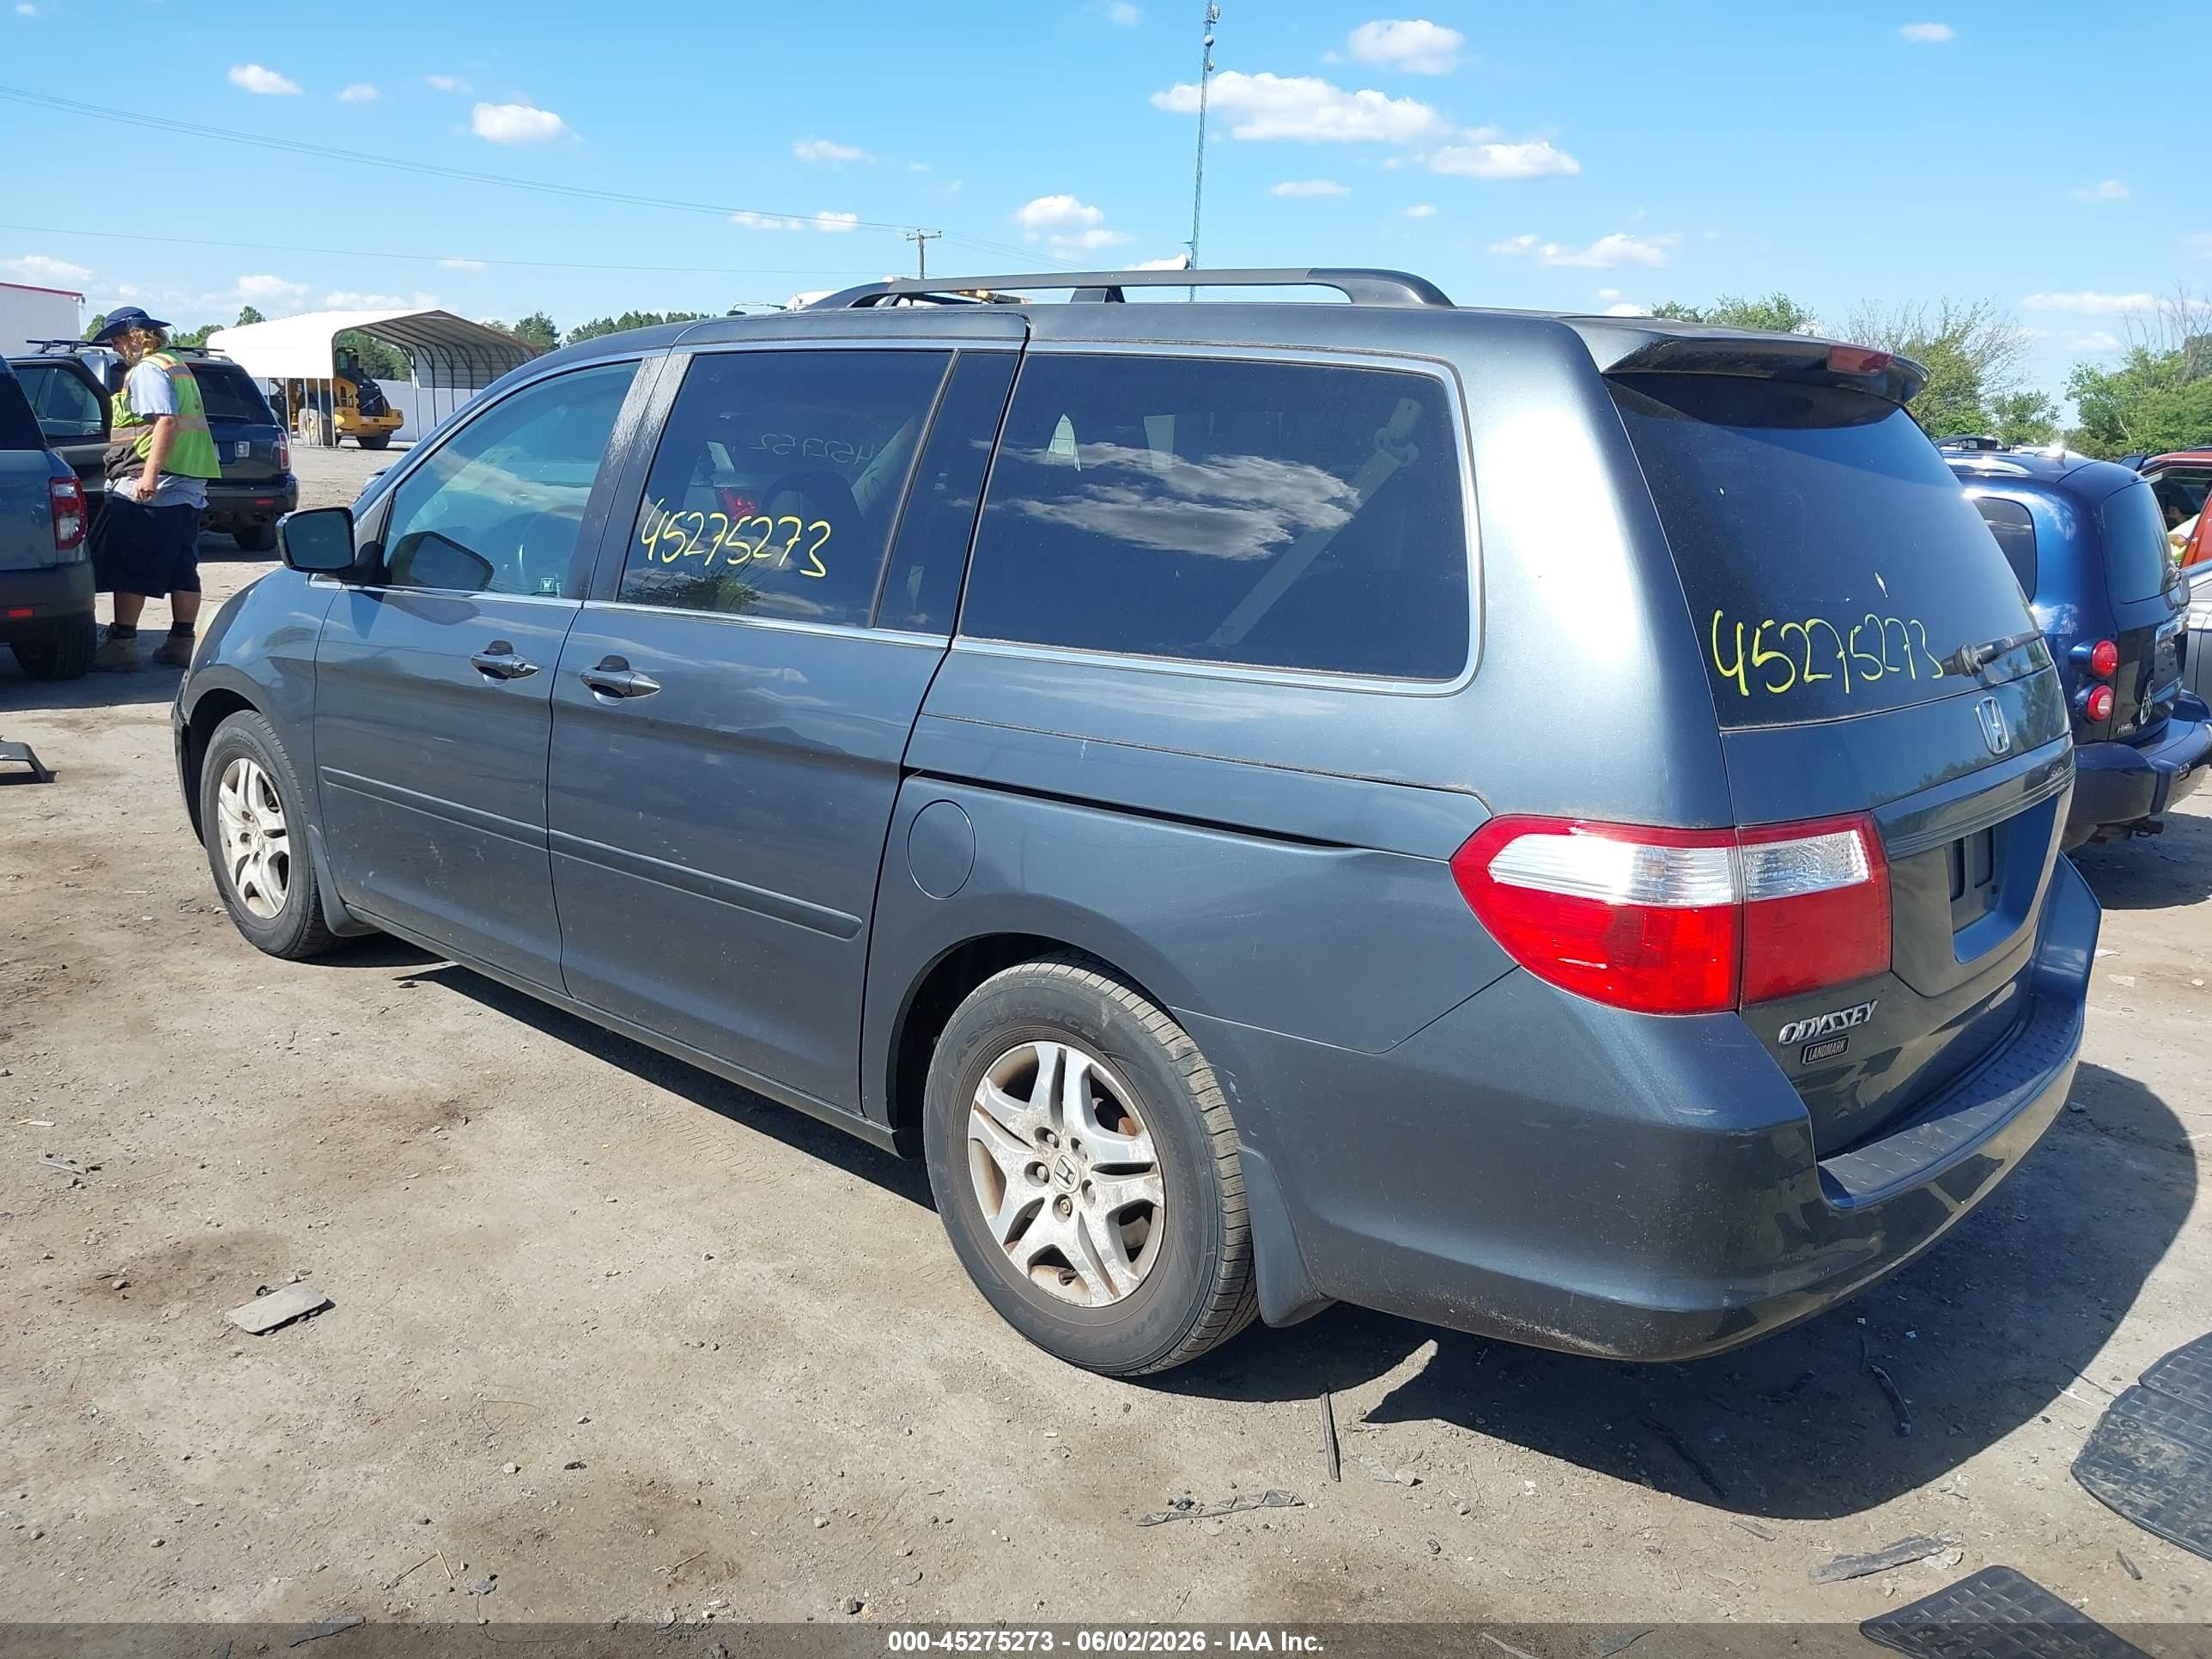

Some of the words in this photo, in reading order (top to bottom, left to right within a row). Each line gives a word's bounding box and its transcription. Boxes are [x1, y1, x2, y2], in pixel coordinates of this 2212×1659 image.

[641, 497, 831, 578] 45275273
[1712, 610, 1945, 696] 45275273
[1778, 999, 1879, 1045] ODYSSEY
[1808, 1038, 1847, 1061] LANDMARK
